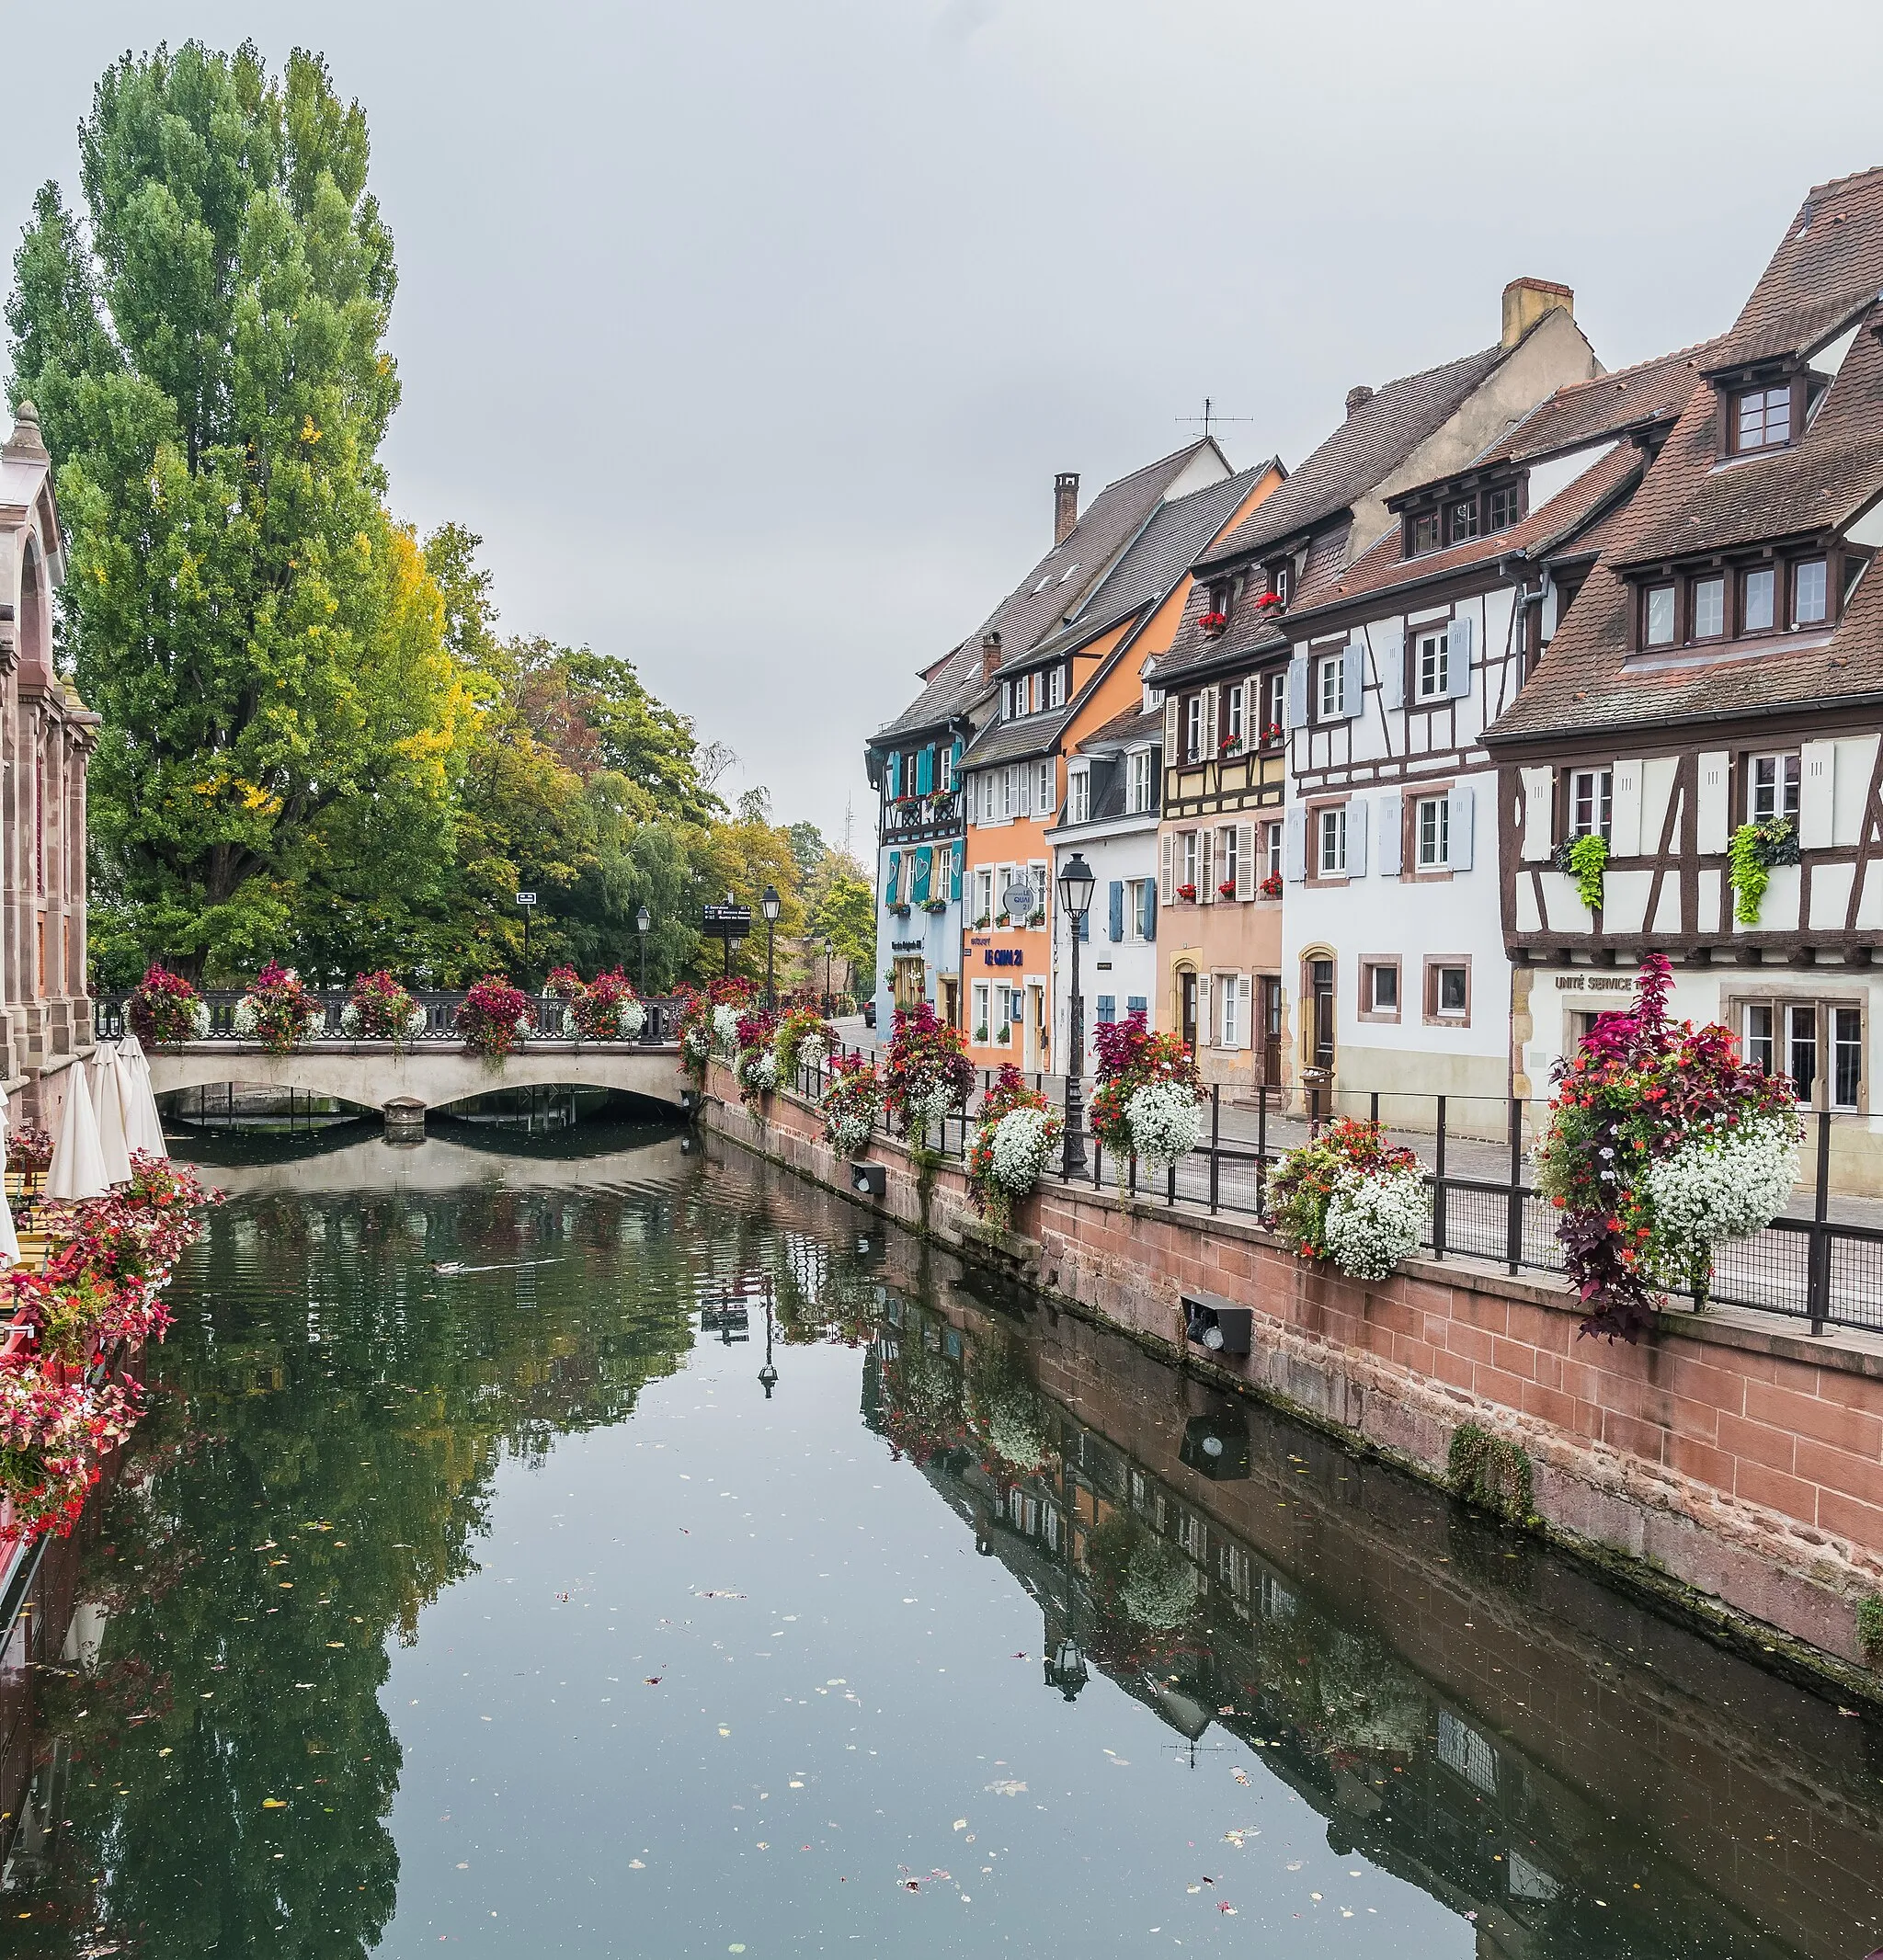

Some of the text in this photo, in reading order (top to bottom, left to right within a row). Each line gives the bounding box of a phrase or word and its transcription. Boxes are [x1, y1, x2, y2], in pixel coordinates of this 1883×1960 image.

[994, 949, 1014, 967] QUAI
[1555, 974, 1585, 991] UNITÉ
[1587, 976, 1633, 991] SERVICE
